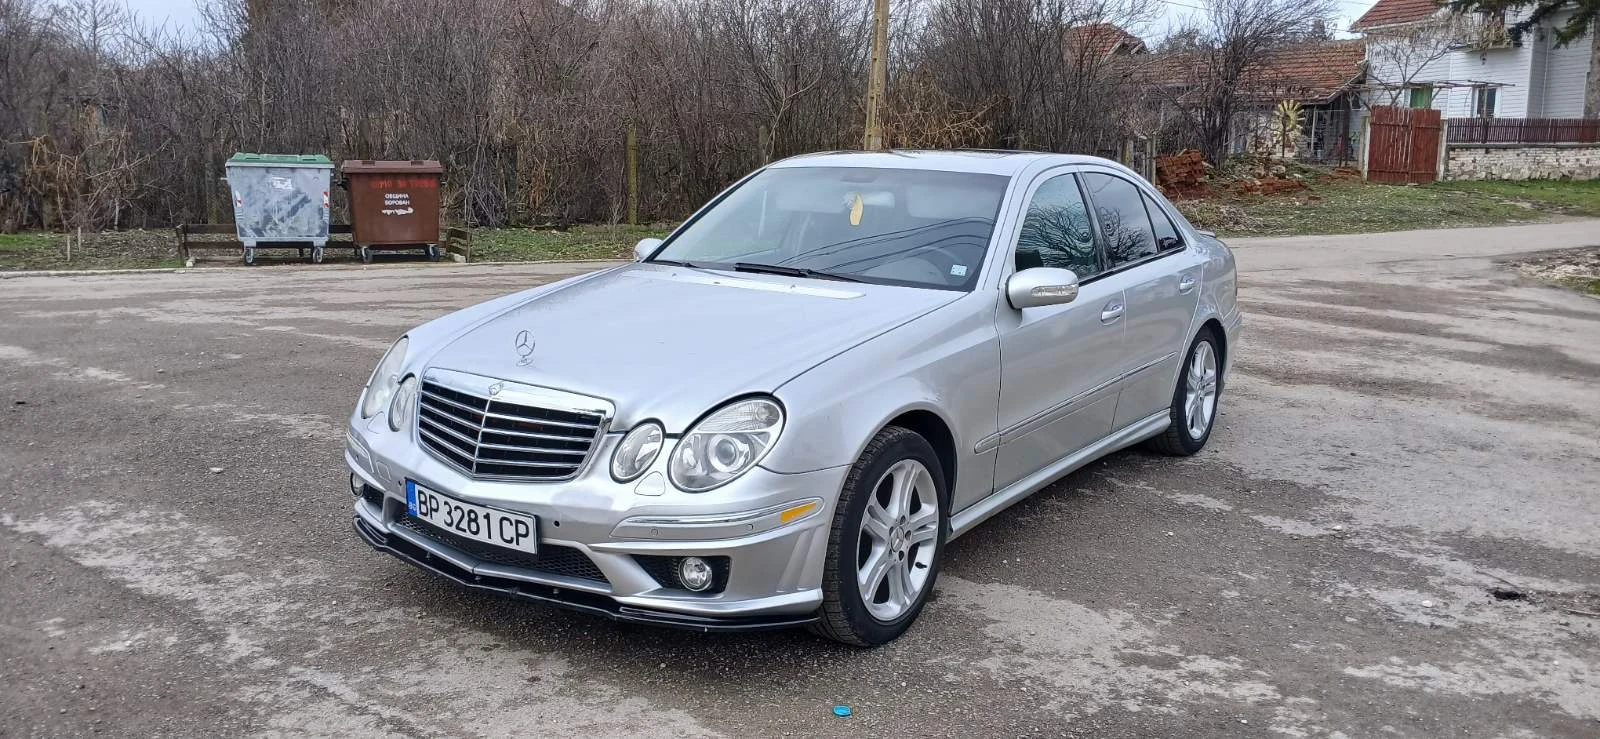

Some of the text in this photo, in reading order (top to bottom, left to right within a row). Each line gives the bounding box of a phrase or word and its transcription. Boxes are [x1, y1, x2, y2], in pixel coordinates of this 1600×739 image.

[418, 489, 530, 546] BP 3281 CP
